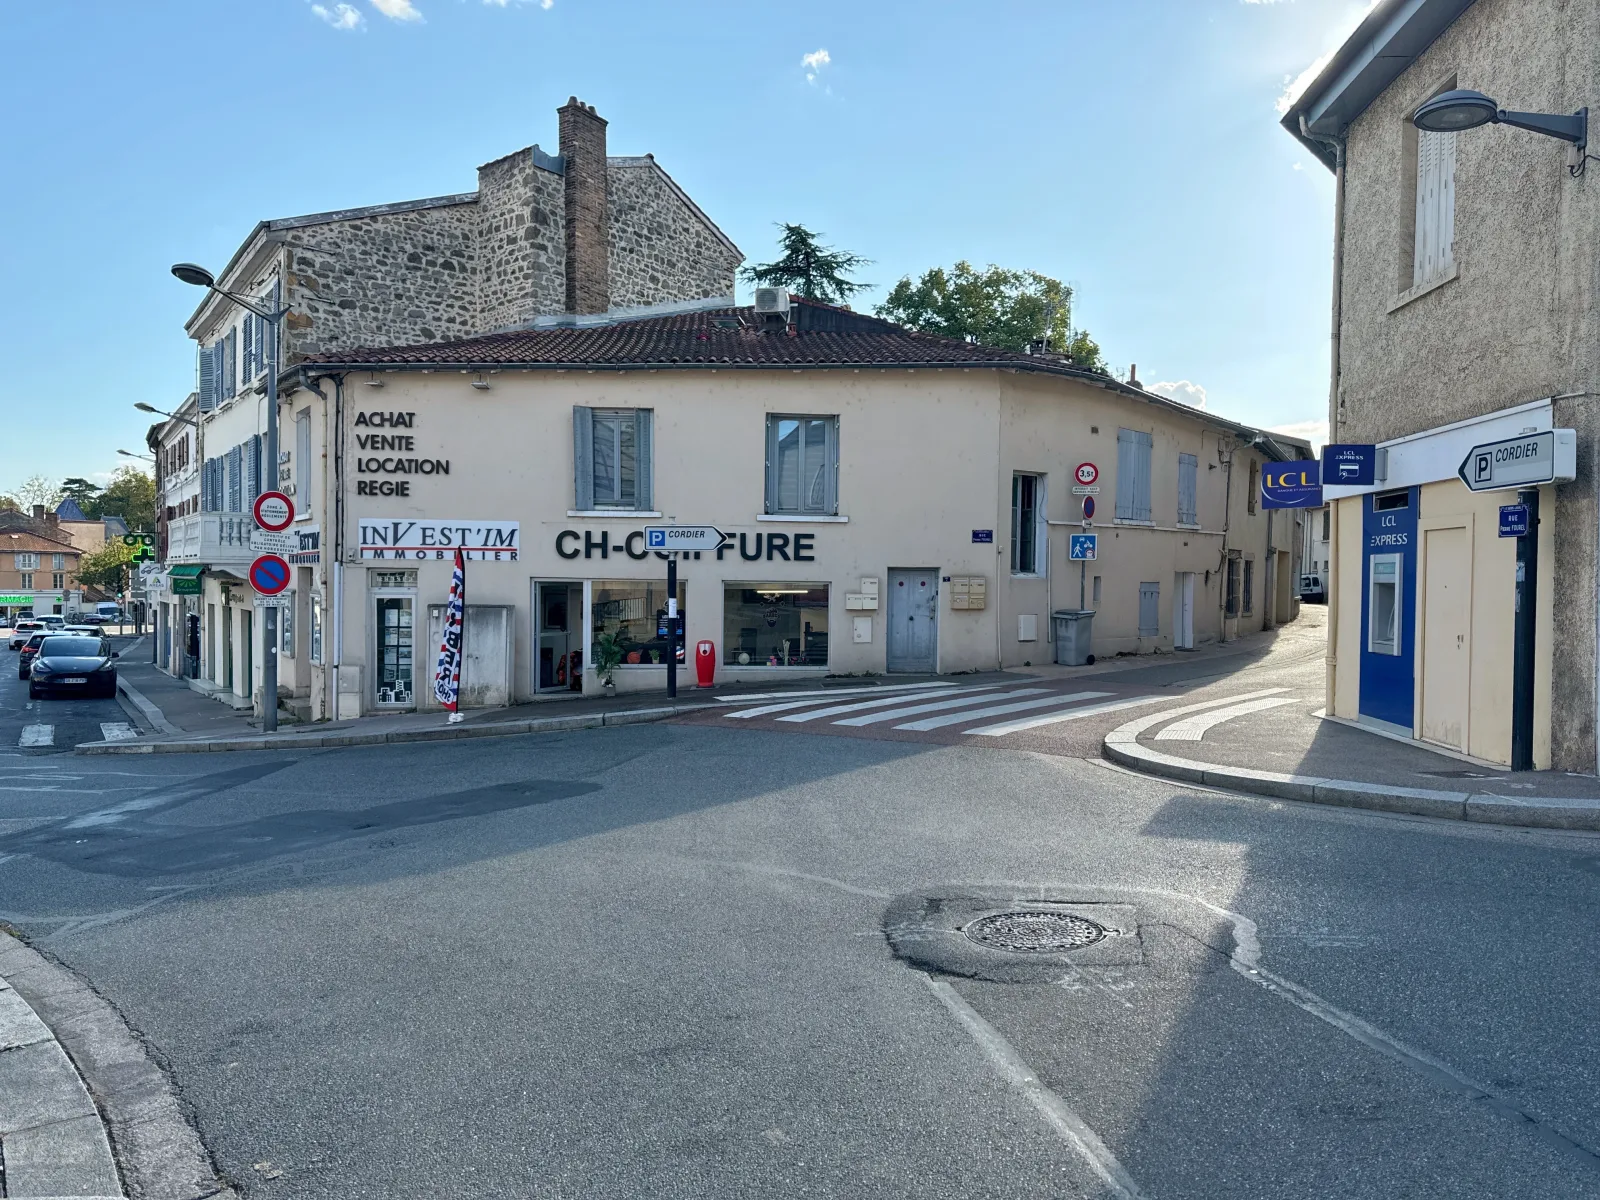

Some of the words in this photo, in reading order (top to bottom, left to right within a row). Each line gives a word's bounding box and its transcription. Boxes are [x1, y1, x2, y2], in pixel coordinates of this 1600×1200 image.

[354, 411, 415, 428] ACHAT
[356, 434, 414, 451] VENTE
[357, 457, 450, 475] LOCATION
[1478, 456, 1489, 479] P
[1495, 442, 1539, 463] CORDIER
[1266, 471, 1316, 488] LCL
[357, 480, 410, 497] REGIE
[1381, 515, 1397, 527] LCL
[555, 530, 815, 561] CH-CFURE
[652, 532, 663, 546] P
[668, 530, 706, 539] CORDIER
[1370, 533, 1408, 546] EXPRESS
[360, 549, 518, 561] IMMOBILIER
